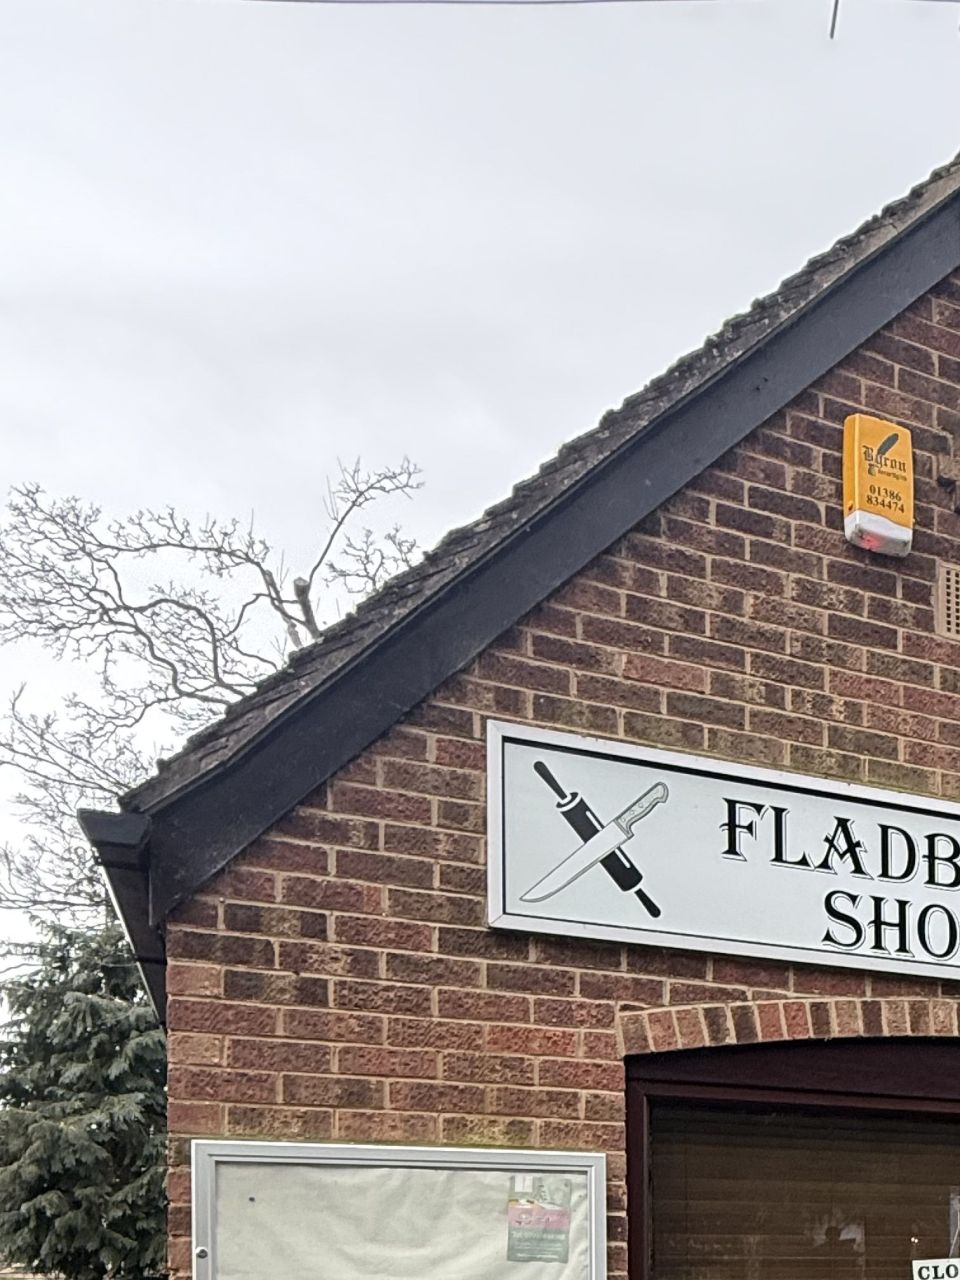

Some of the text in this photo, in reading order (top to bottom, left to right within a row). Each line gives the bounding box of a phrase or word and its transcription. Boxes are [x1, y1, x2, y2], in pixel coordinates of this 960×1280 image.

[862, 445, 906, 473] Byron
[869, 484, 903, 502] 01386
[866, 495, 905, 513] 834474
